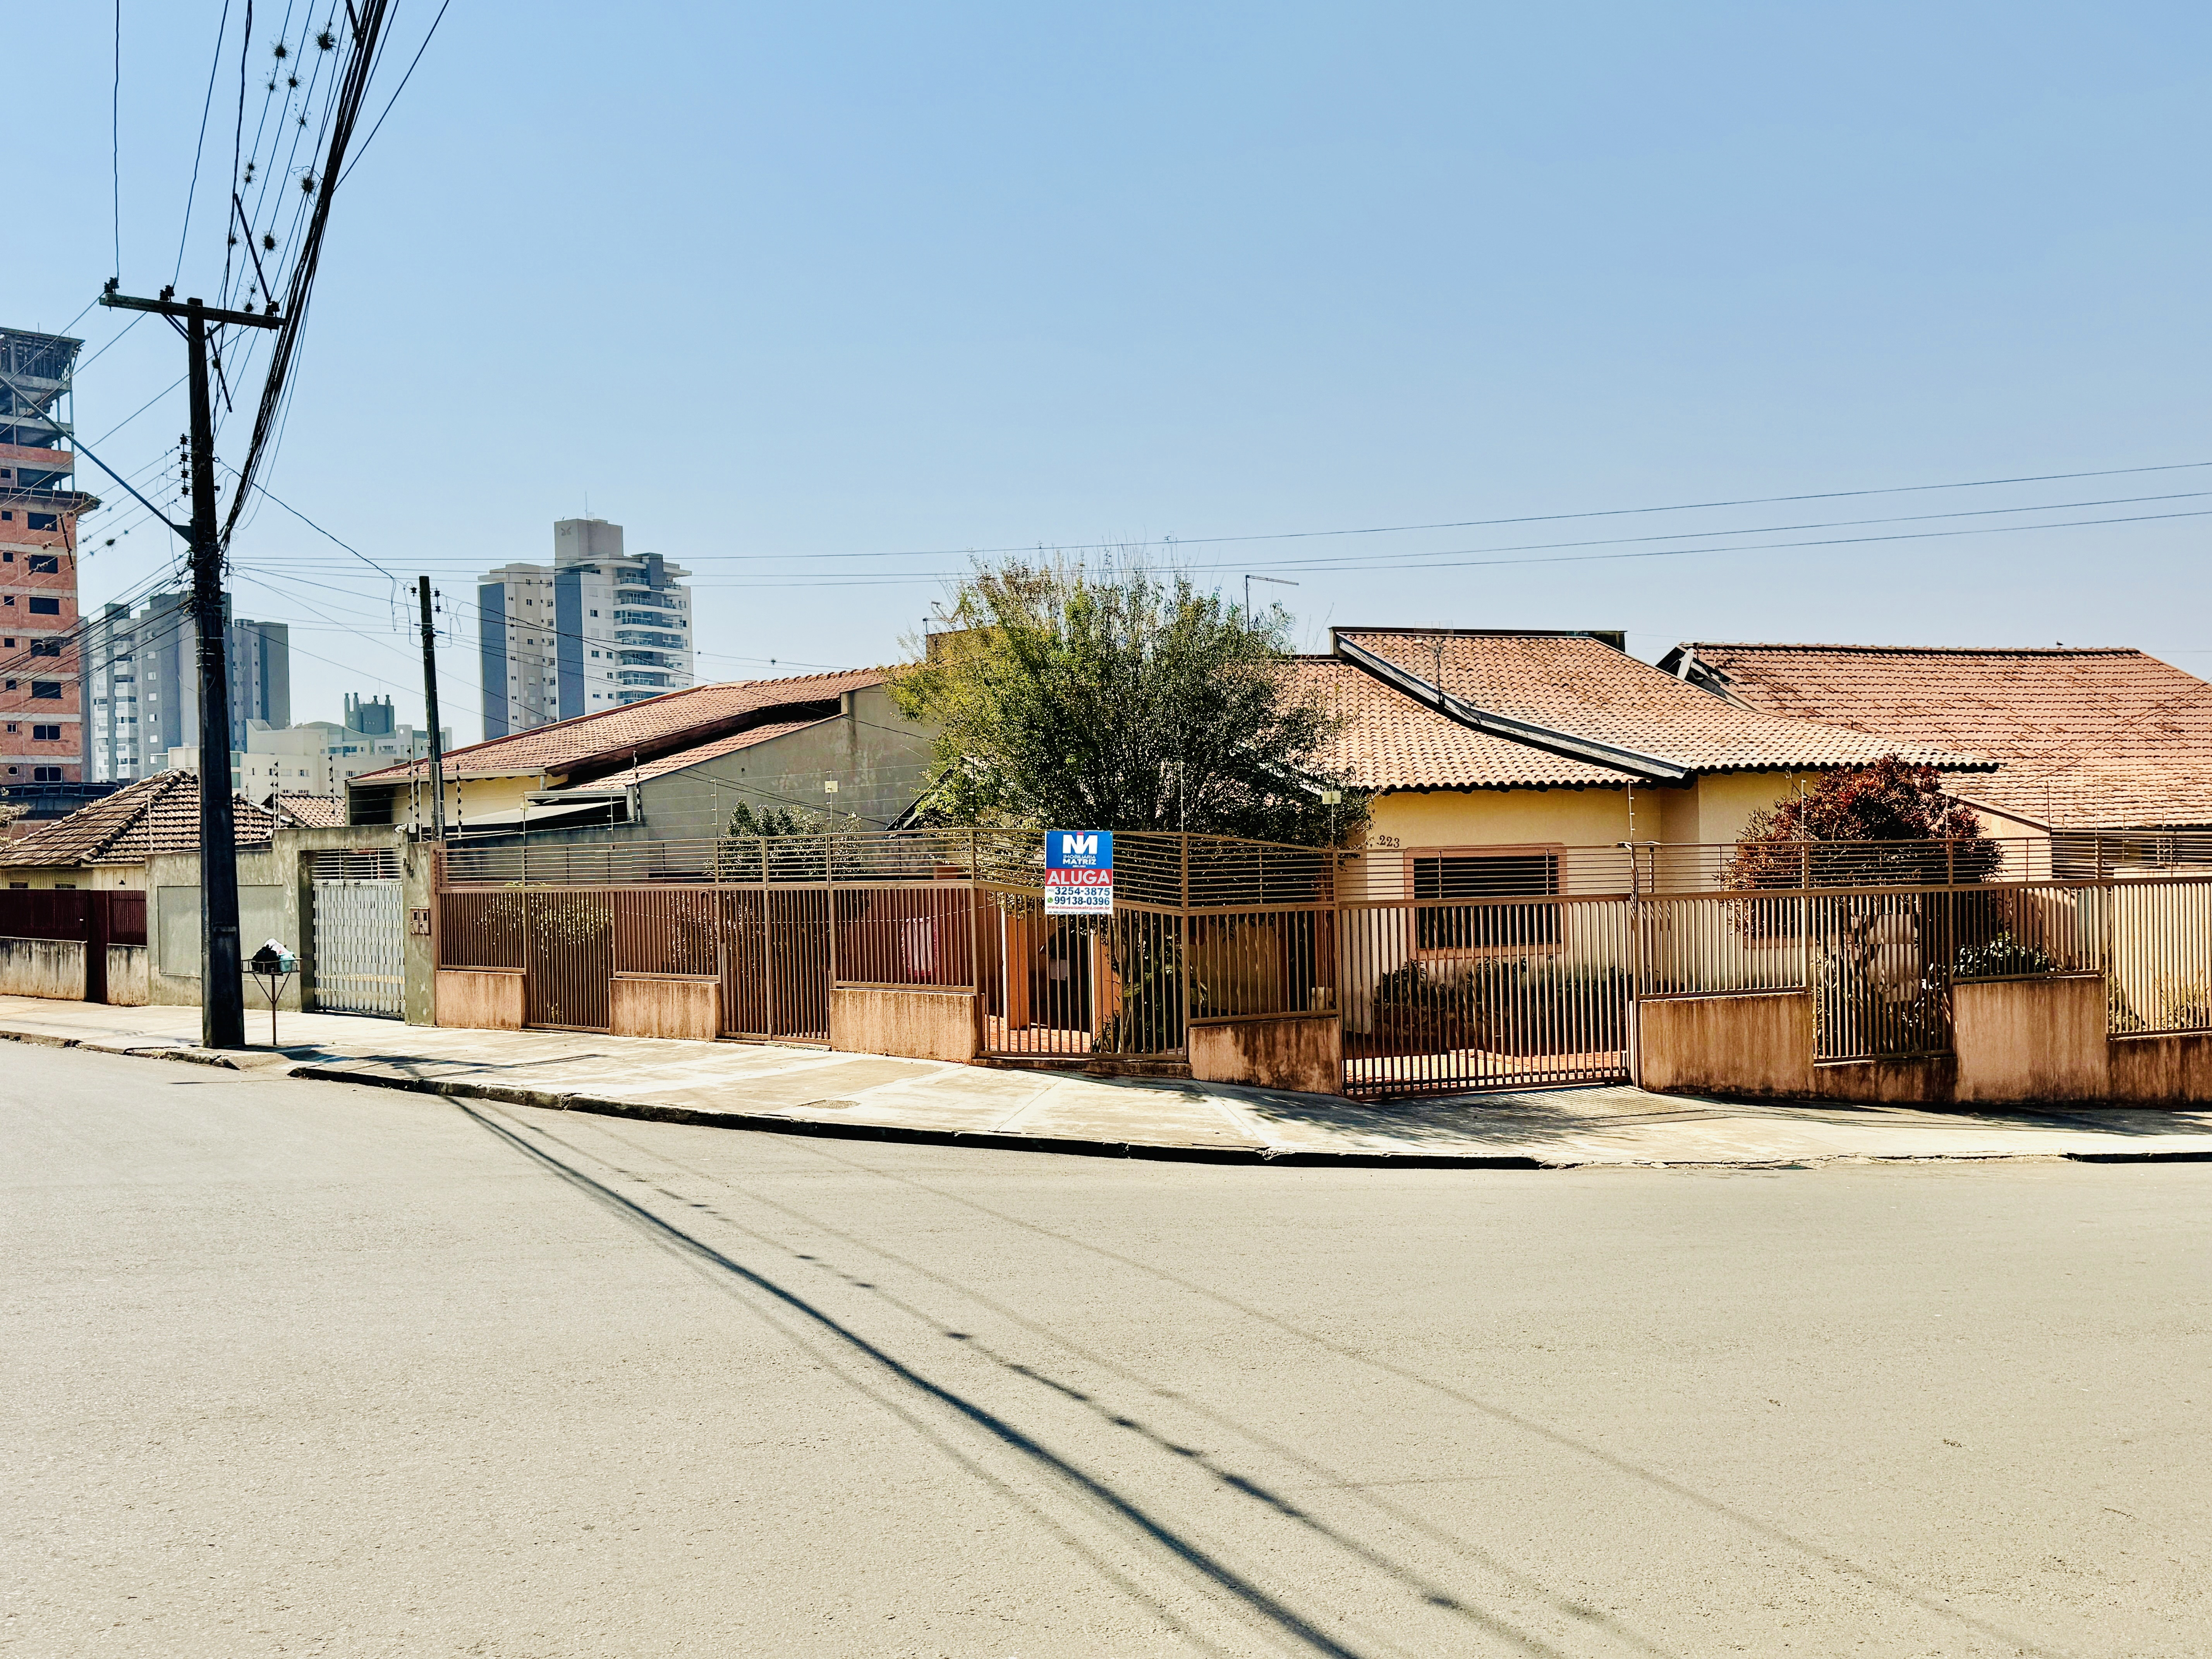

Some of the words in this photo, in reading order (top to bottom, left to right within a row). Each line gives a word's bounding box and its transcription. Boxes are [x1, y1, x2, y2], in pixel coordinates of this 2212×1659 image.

[1379, 835, 1400, 848] 223
[1047, 870, 1109, 884] ALUGA
[1054, 886, 1110, 896] 3254-3875
[1054, 896, 1110, 905] 99138-0396
